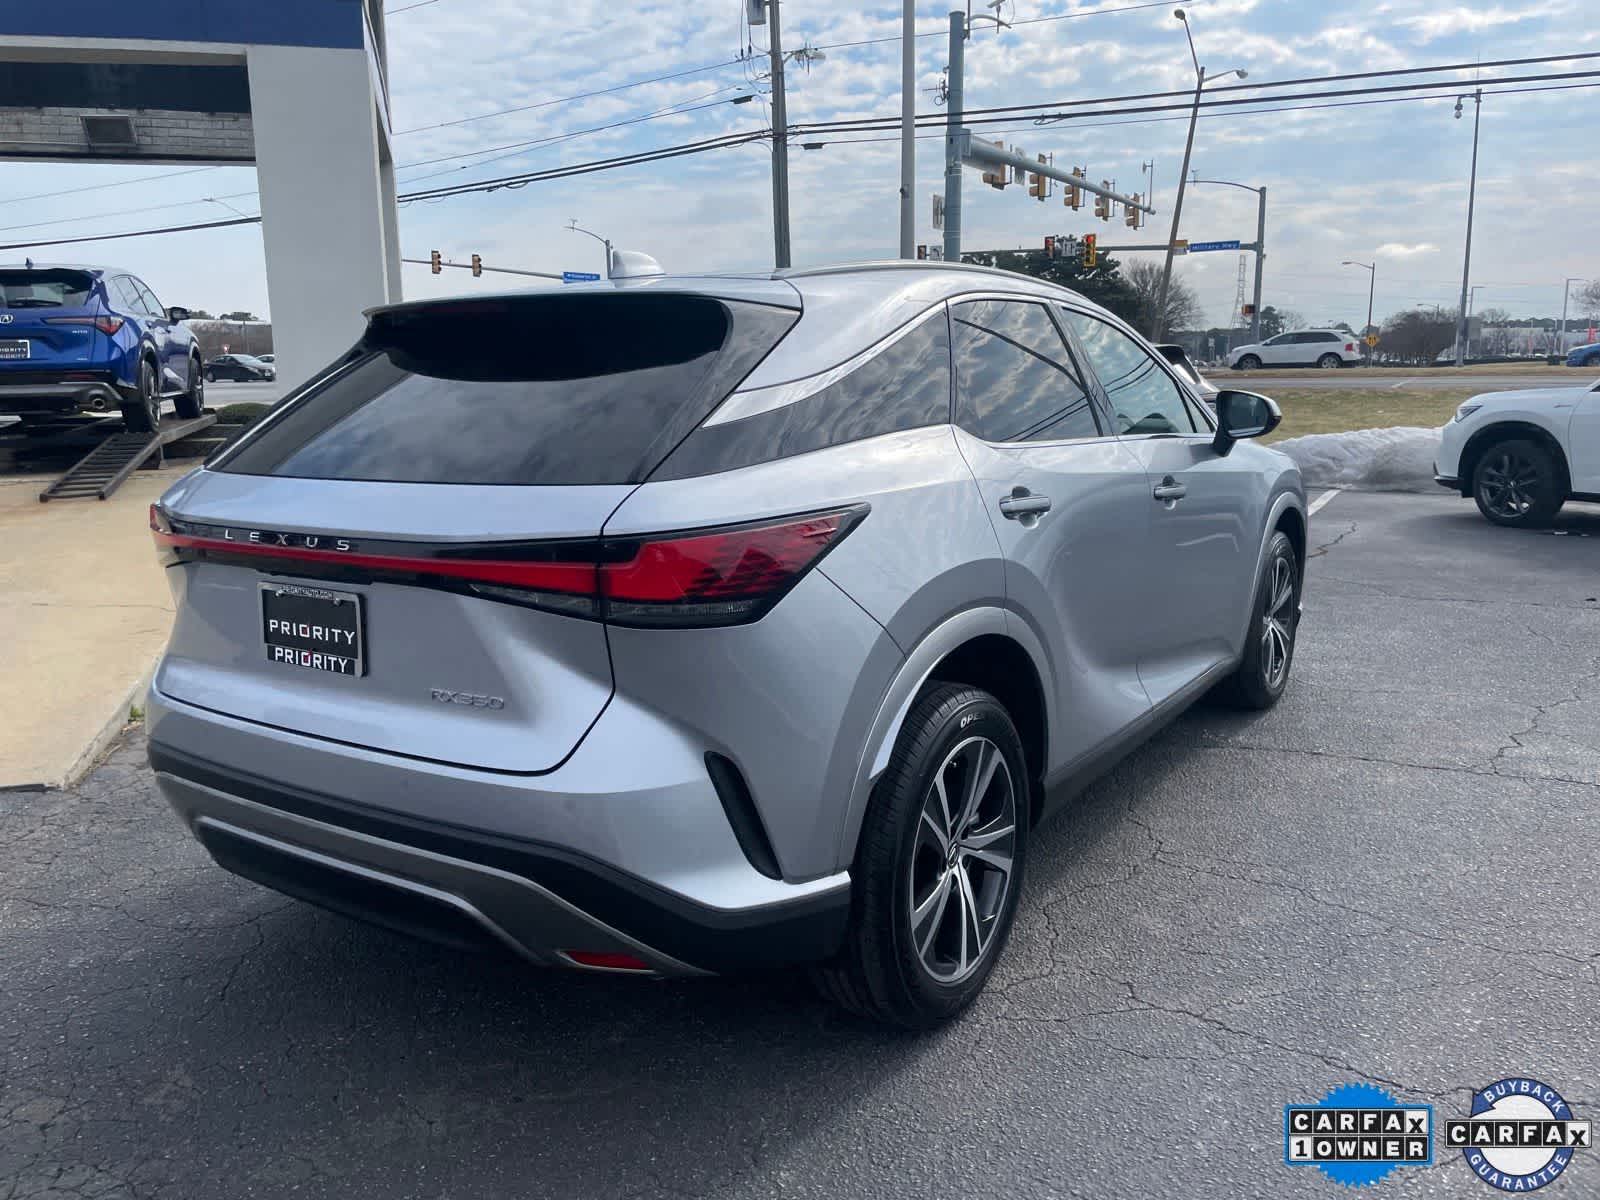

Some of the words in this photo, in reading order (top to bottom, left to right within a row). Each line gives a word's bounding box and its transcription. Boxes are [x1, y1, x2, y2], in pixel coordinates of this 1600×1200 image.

[224, 528, 350, 551] LEXUS
[269, 618, 356, 645] PRIORITY
[274, 646, 348, 673] PRIORITY
